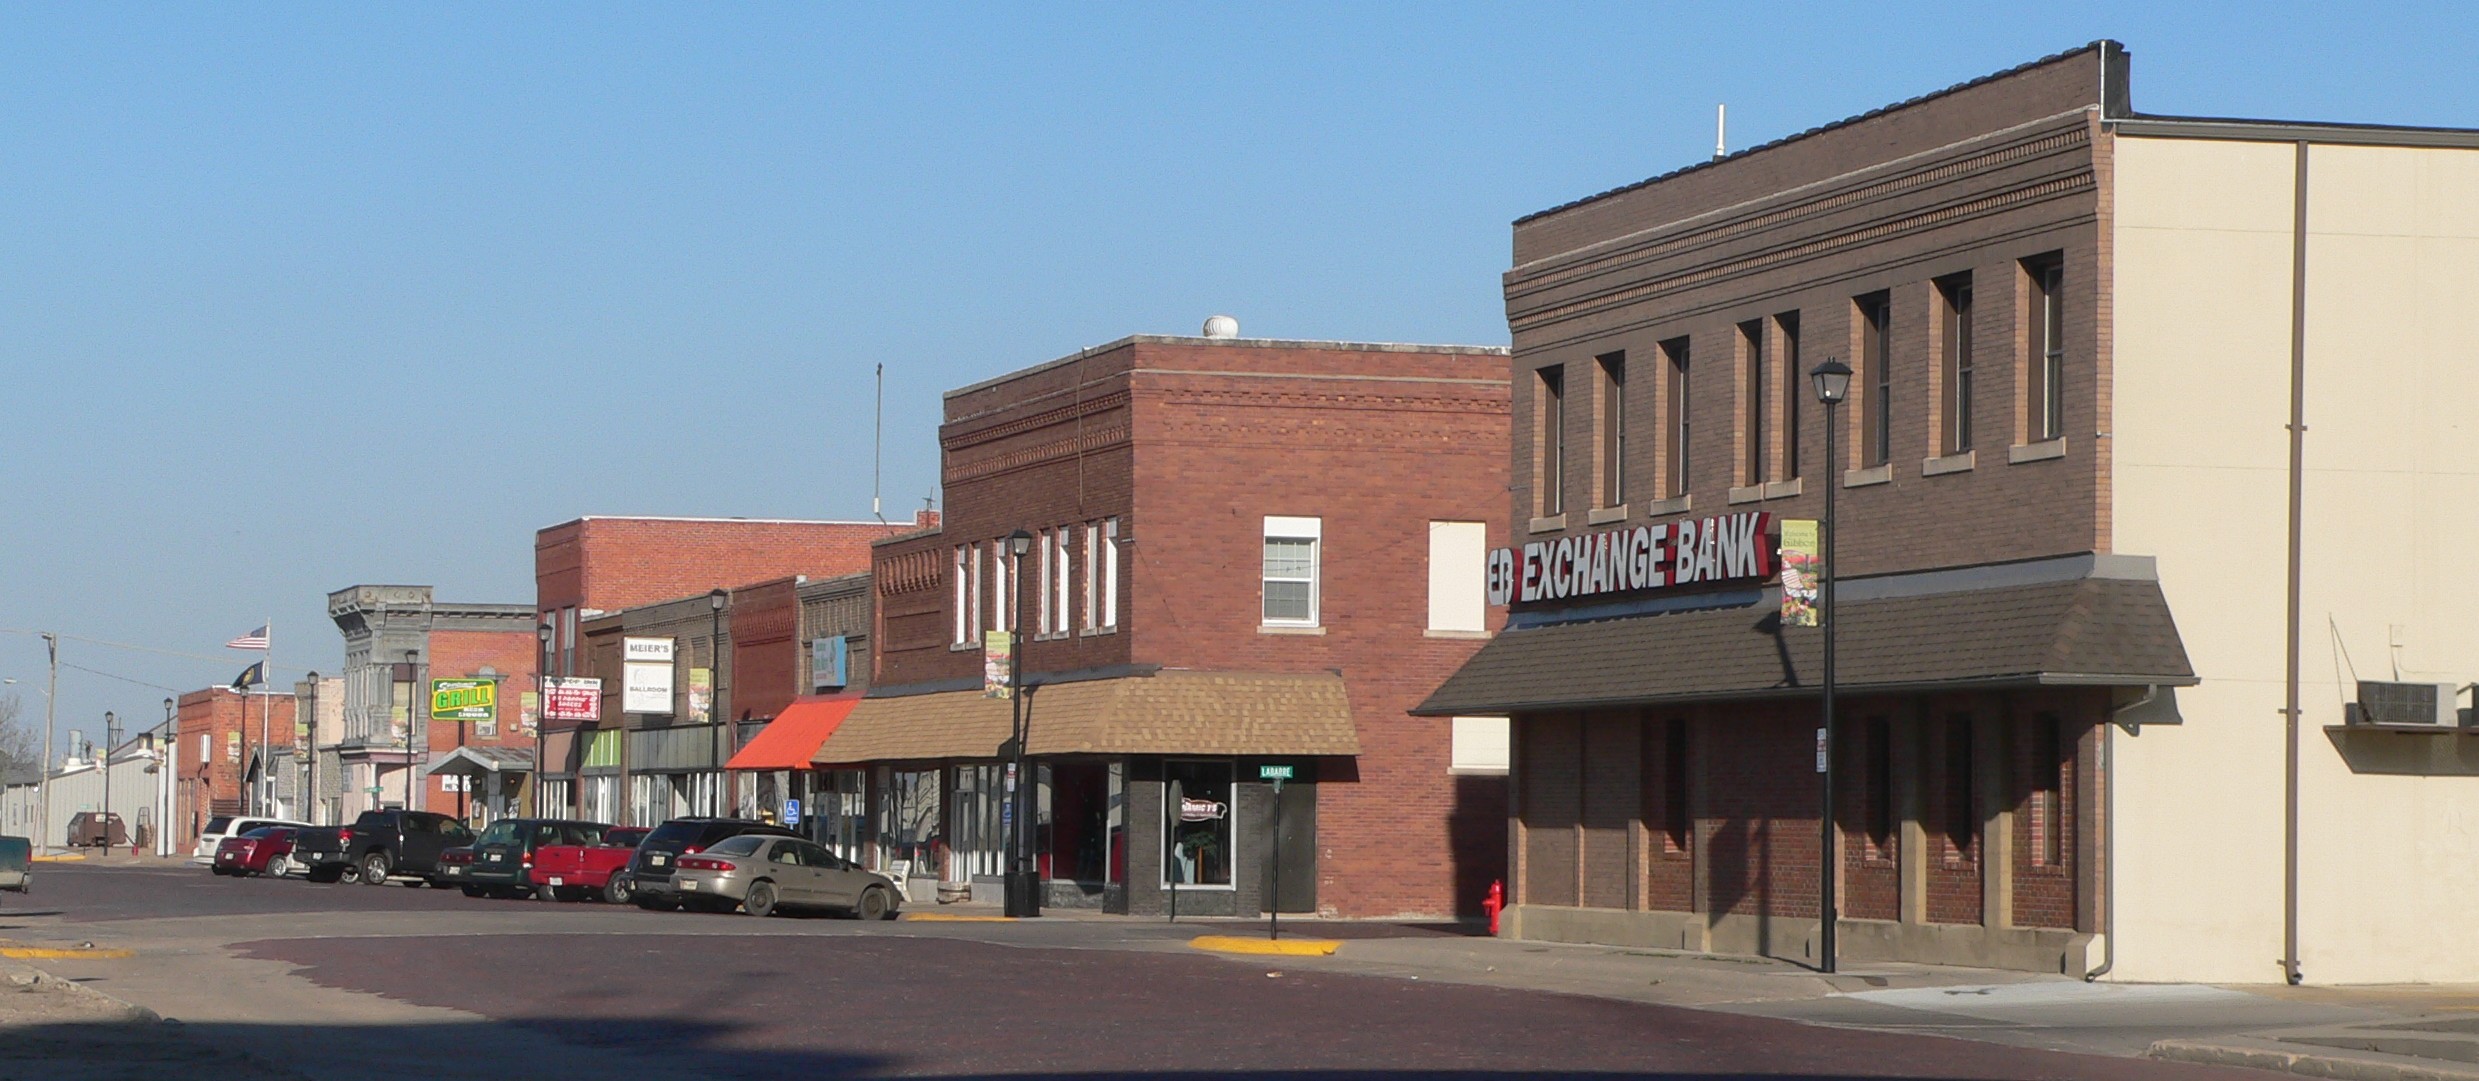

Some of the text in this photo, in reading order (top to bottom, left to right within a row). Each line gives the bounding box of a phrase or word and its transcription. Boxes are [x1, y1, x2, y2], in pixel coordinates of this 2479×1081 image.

[1783, 539, 1816, 547] Gibbon
[1521, 511, 1760, 602] EXCHANGE BANK
[630, 644, 669, 653] MEIER'S
[436, 688, 490, 709] GRILL
